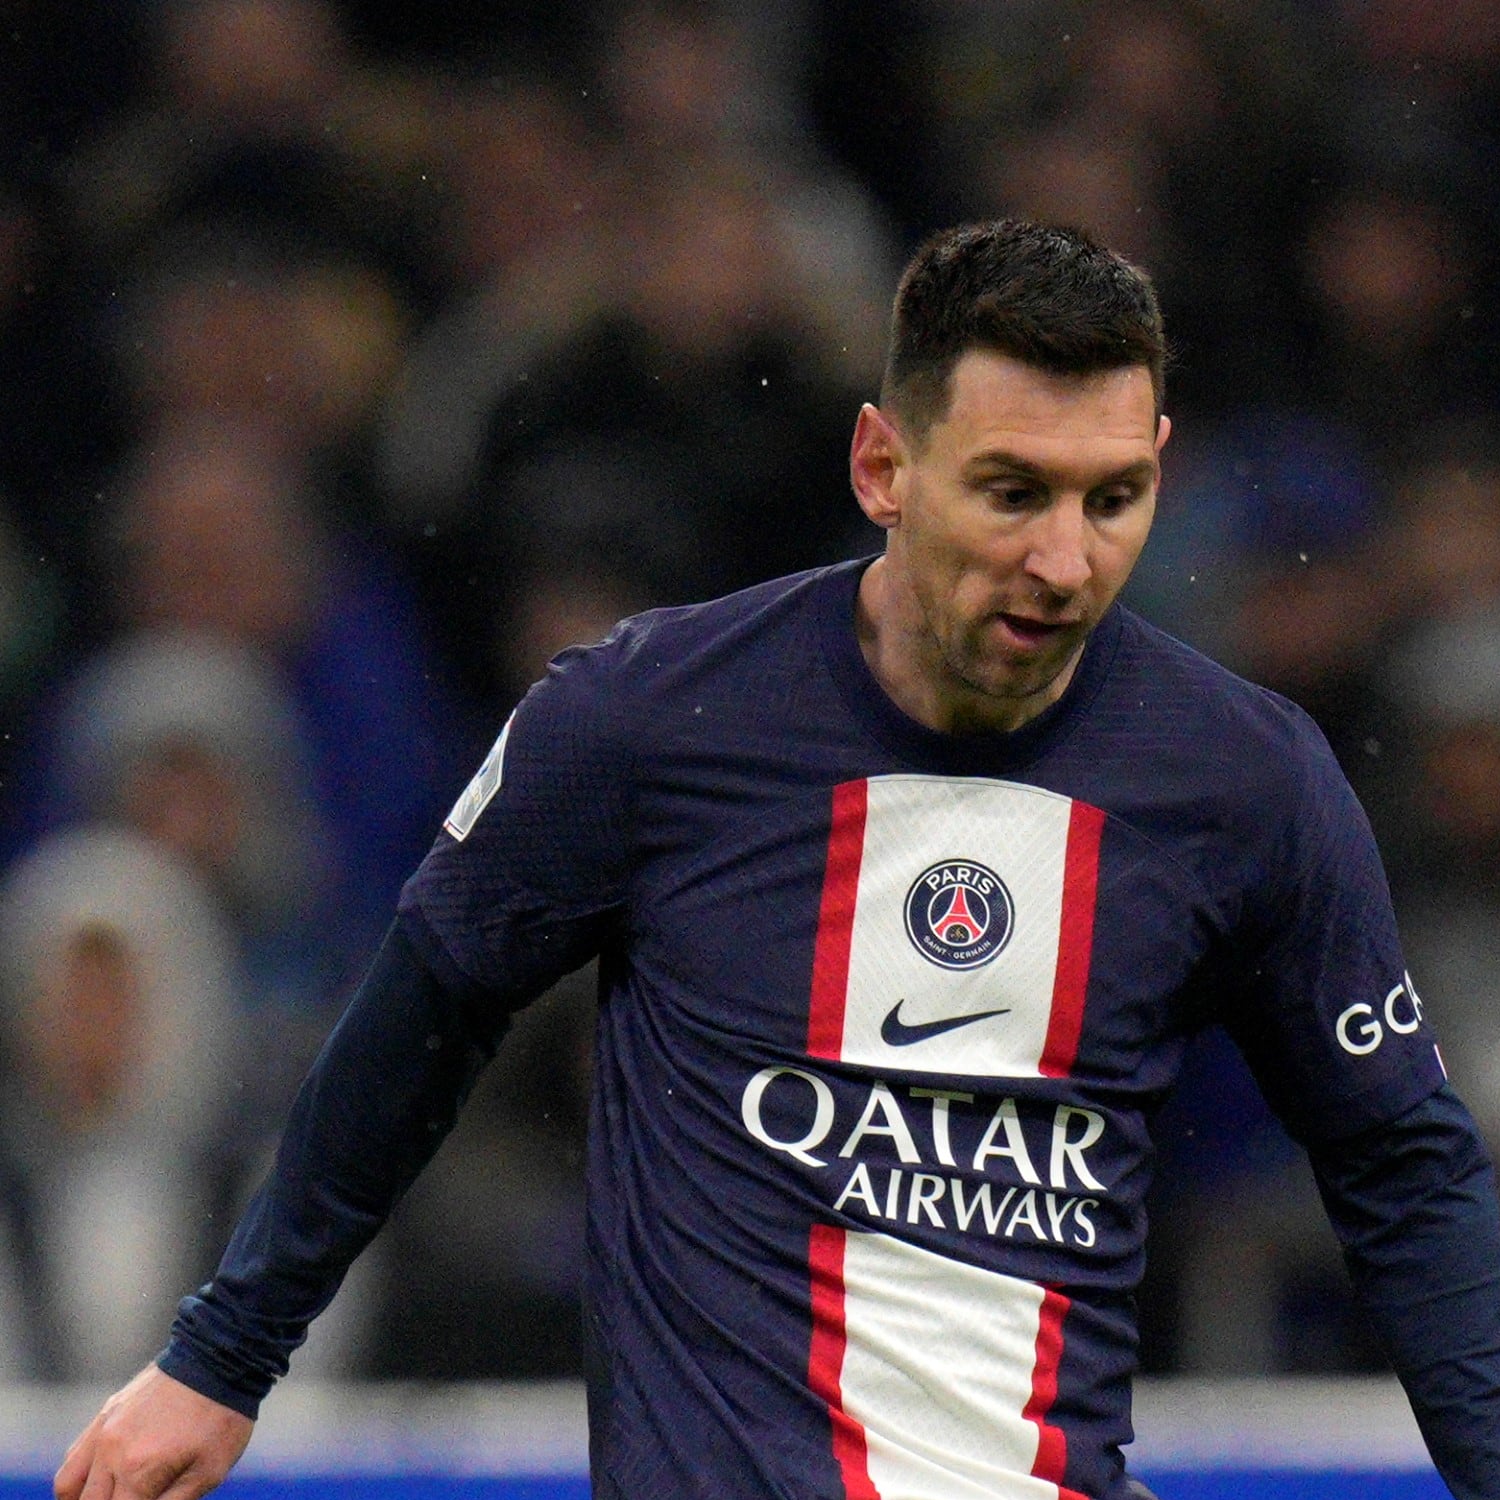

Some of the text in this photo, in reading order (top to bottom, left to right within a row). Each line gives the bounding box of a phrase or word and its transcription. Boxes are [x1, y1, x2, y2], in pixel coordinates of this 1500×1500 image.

[926, 867, 994, 895] PARIS
[741, 1066, 1107, 1192] QATAR
[833, 1162, 1100, 1249] AIRWAYS
